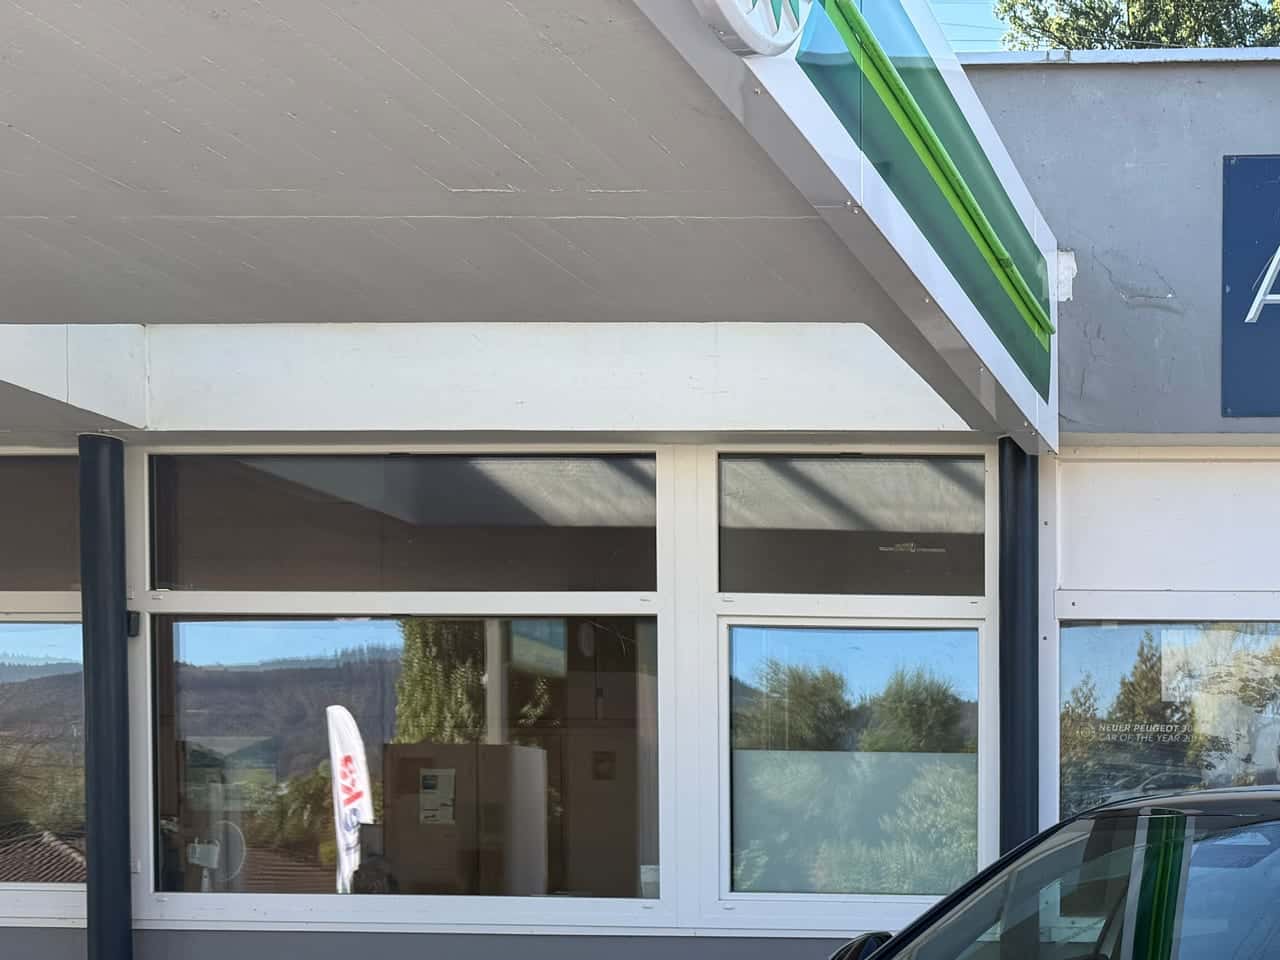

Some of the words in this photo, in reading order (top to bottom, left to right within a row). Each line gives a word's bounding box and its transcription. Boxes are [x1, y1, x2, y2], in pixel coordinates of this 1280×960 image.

[1098, 723, 1131, 732] NEUER
[1133, 723, 1181, 732] PEUGEOT
[1098, 733, 1117, 742] CAR
[1119, 733, 1132, 742] OF
[1136, 733, 1153, 742] THE
[1156, 733, 1181, 742] YEAR
